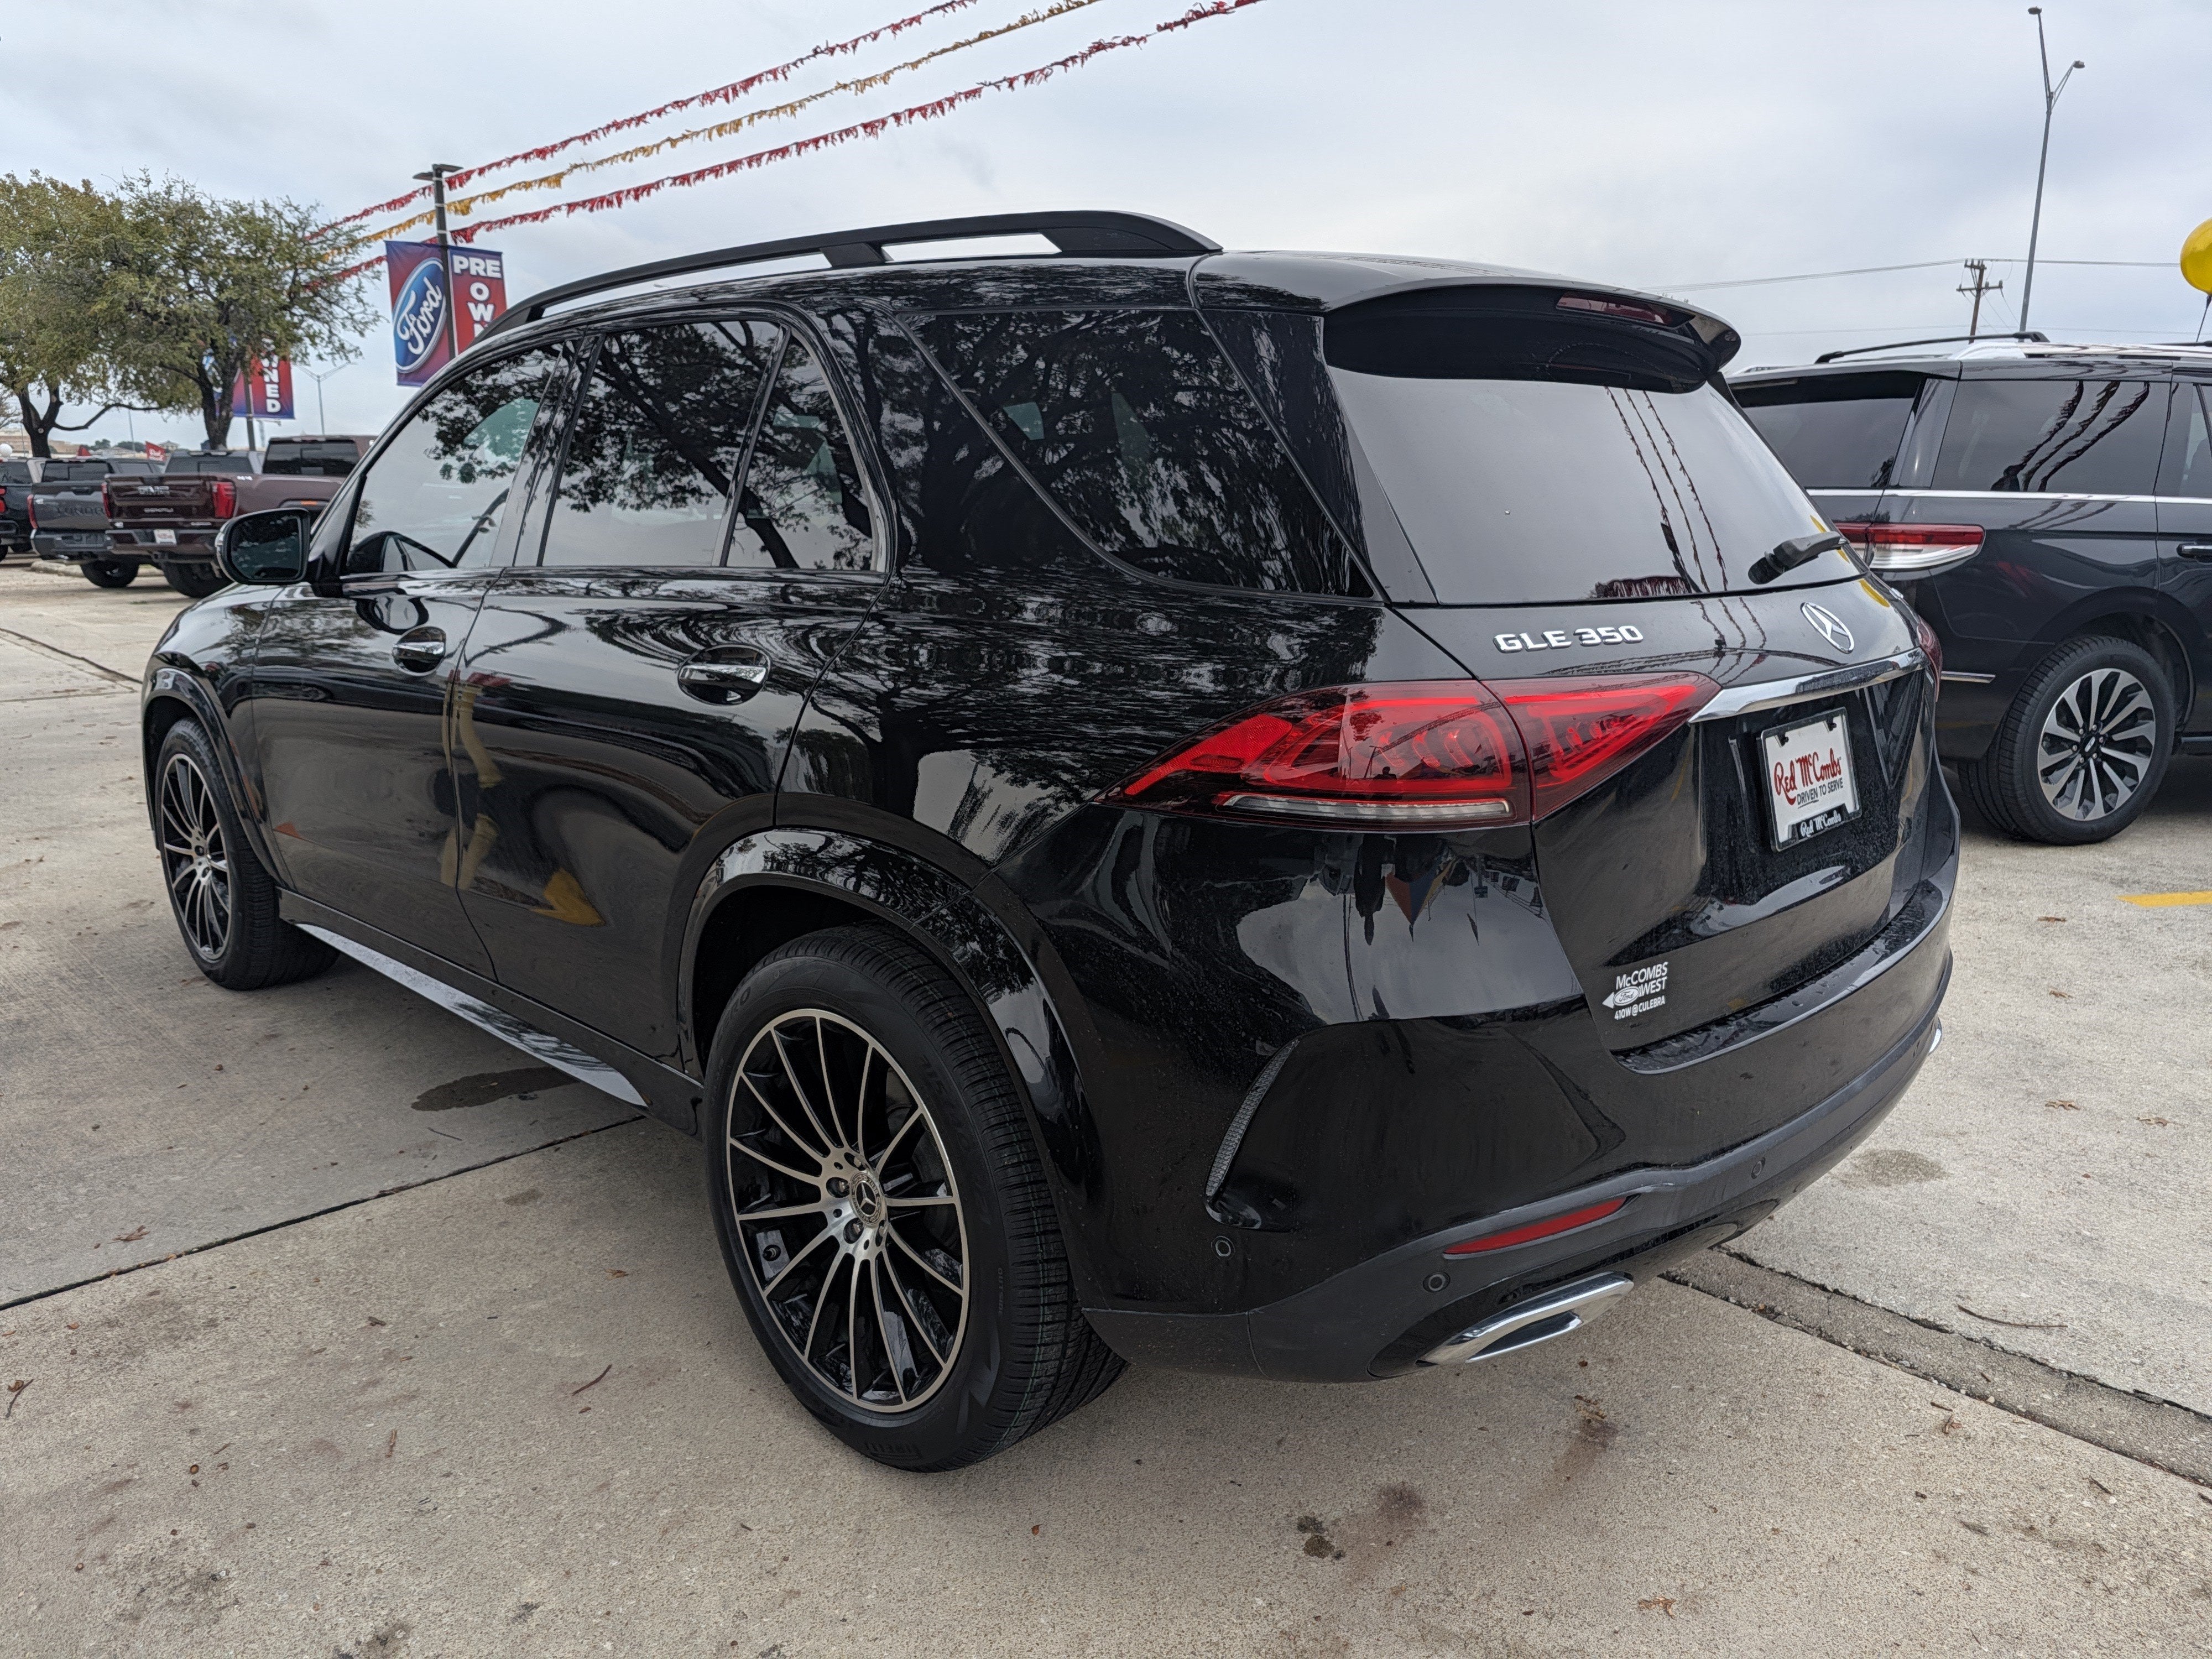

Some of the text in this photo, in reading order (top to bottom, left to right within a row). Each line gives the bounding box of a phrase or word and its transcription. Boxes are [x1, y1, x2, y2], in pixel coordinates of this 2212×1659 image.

[452, 254, 502, 278] PRE
[397, 276, 442, 354] Ford
[55, 507, 105, 517] TUNDR
[1493, 625, 1644, 653] GLE 350
[1773, 748, 1842, 806] Red McCombs
[1797, 777, 1844, 805] DRIVEN TO SERVE
[1800, 810, 1842, 838] Red McCombs
[1616, 961, 1668, 990] McCOMBS
[1640, 976, 1668, 997] WEST
